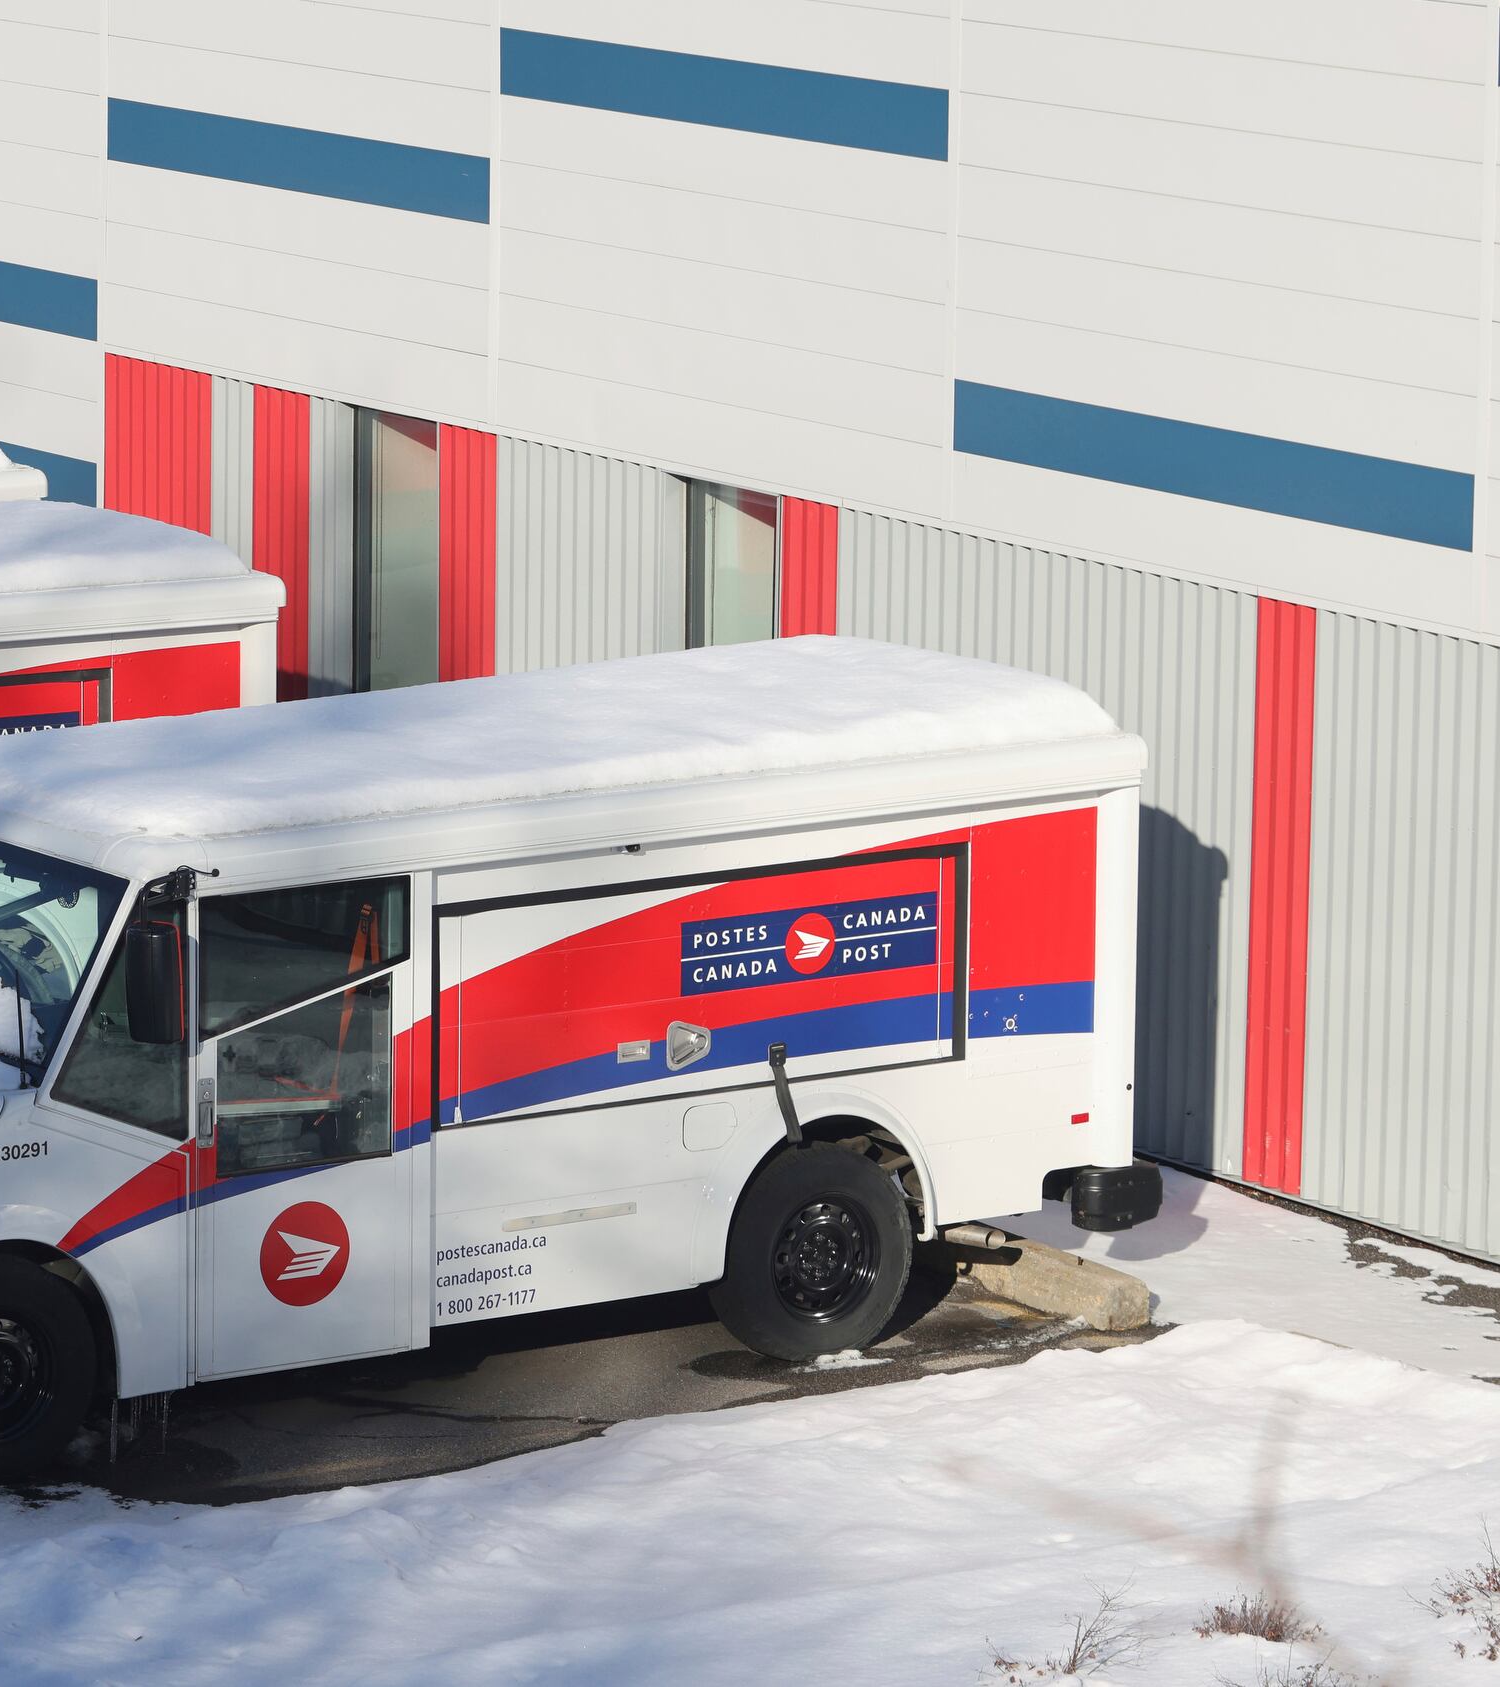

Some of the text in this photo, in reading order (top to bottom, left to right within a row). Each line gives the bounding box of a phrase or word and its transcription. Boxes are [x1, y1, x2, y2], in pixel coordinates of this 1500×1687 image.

[692, 905, 926, 949] POSTES CANADA
[692, 942, 892, 984] CANADA POST
[436, 1234, 547, 1265] postescanada.ca
[436, 1264, 532, 1289] canadapost.ca
[436, 1288, 536, 1316] 1 800 267-1177
